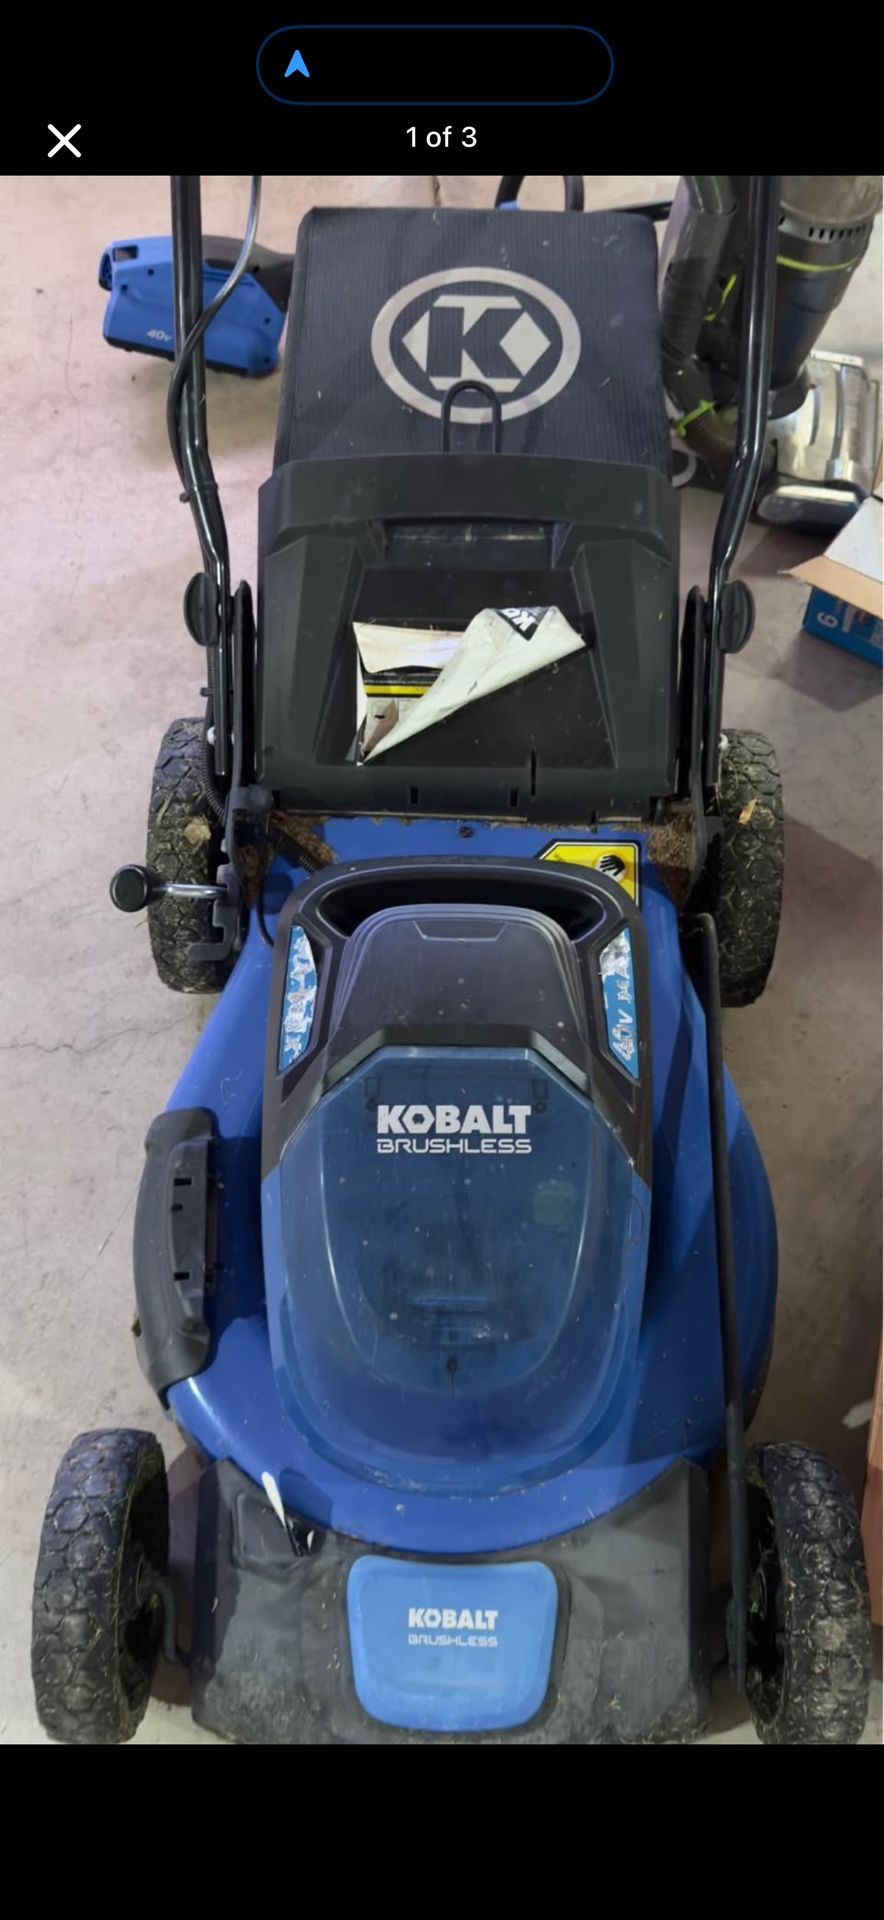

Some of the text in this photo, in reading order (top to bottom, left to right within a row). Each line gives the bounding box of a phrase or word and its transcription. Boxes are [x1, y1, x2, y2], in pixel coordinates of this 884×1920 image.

[377, 1104, 532, 1134] KOBALT
[376, 1138, 533, 1154] BRUSHLESS
[408, 1607, 499, 1630] KOBALT
[408, 1634, 498, 1647] BRUSHLESS
